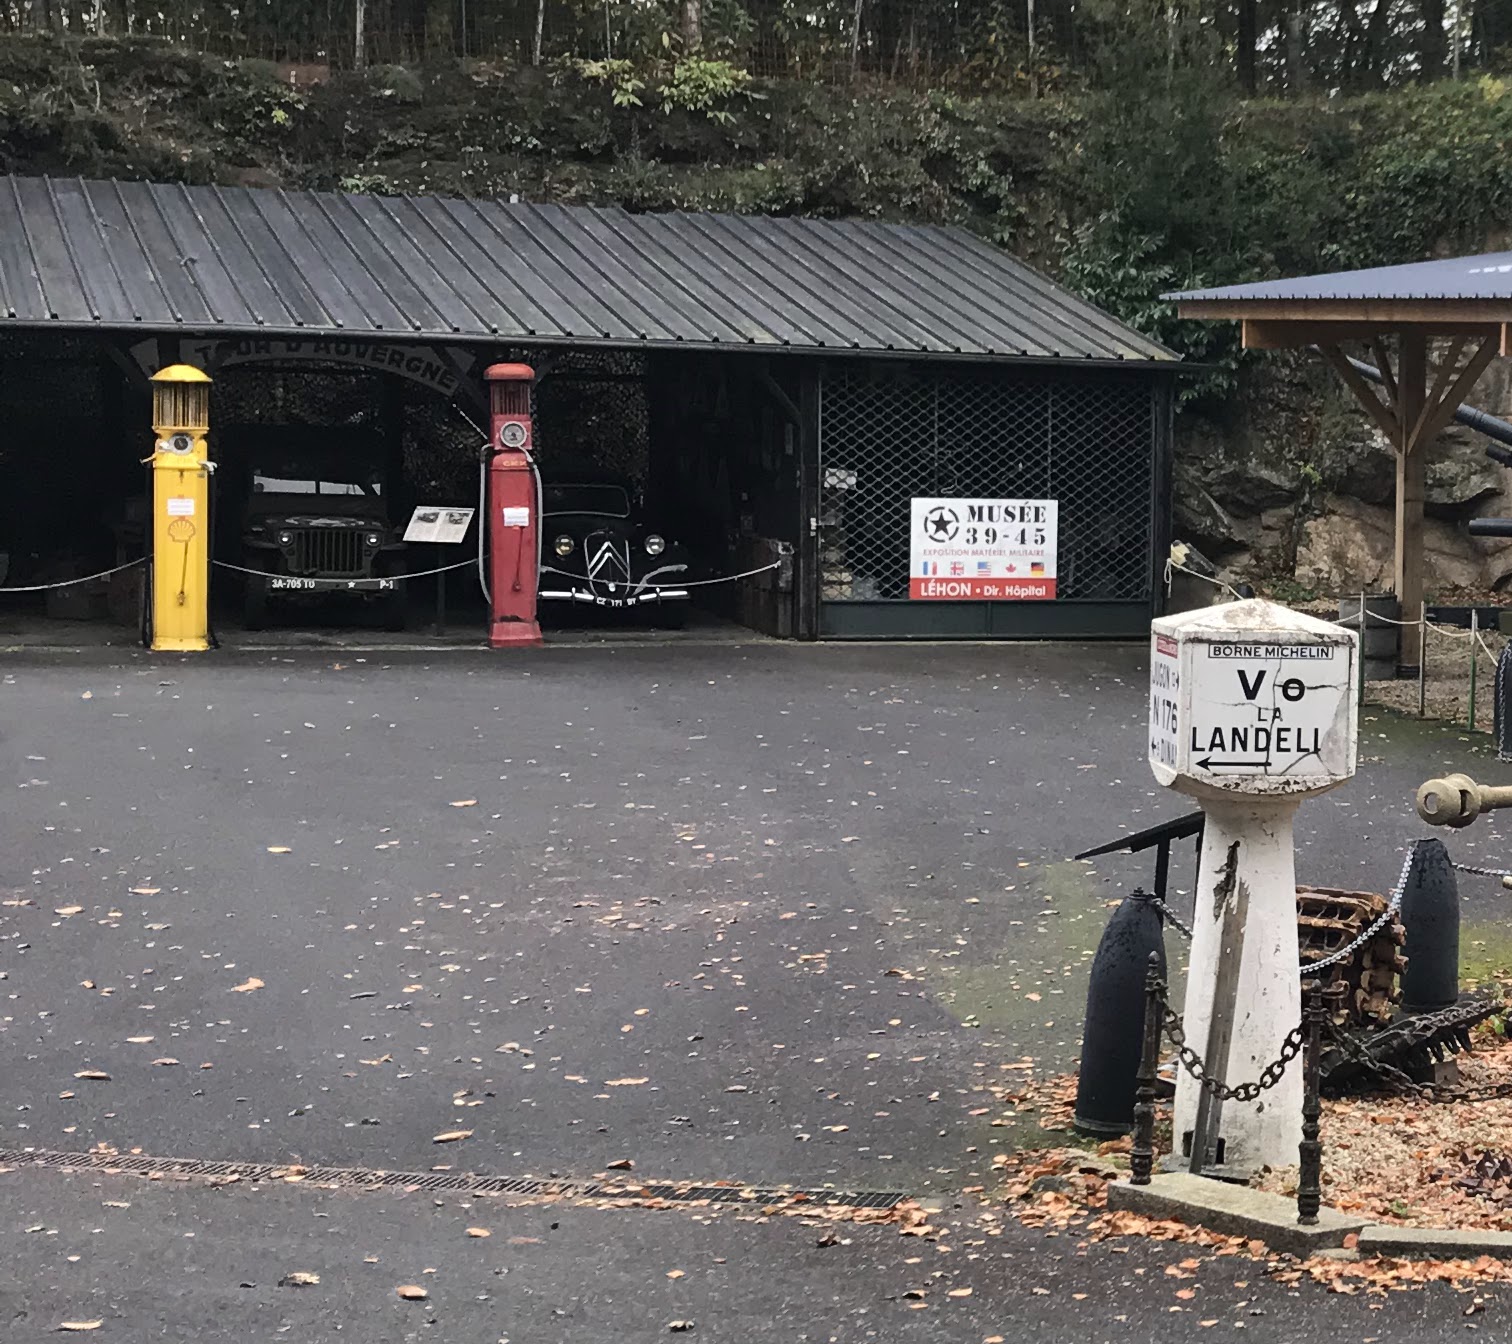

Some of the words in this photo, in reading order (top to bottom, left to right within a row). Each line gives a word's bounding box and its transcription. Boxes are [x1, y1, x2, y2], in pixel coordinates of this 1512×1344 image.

[967, 501, 1047, 523] MUSÉE
[966, 527, 1046, 545] 39-45
[923, 549, 970, 557] EXPOSITION
[1009, 549, 1045, 557] MILITAIRE
[380, 580, 393, 589] P-1
[921, 579, 972, 597] LÉHON
[984, 585, 1002, 597] Dir.
[1005, 585, 1046, 599] Hôpital
[1213, 645, 1262, 657] BORNE
[1265, 646, 1330, 658] MICHELIN
[1162, 699, 1178, 734] 176
[1258, 707, 1283, 722] LA
